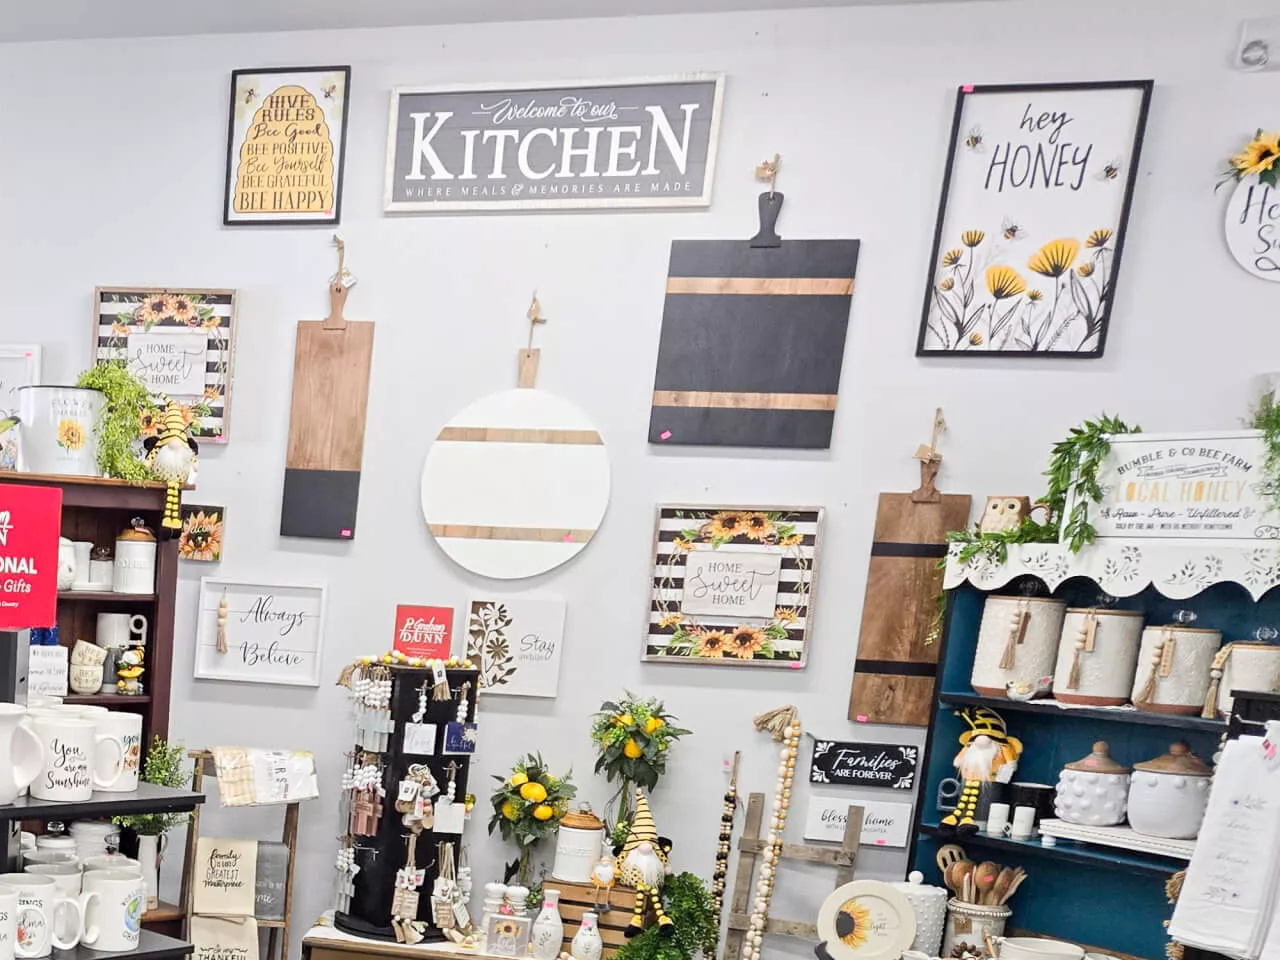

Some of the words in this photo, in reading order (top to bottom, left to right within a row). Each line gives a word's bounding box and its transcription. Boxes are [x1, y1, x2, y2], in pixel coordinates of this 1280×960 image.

[270, 95, 310, 108] HIVE
[481, 97, 565, 124] Welcome
[562, 97, 588, 121] to
[589, 102, 619, 122] our
[262, 108, 315, 122] RULES
[1020, 103, 1074, 144] hey
[253, 122, 279, 140] Bee
[284, 122, 322, 142] Good
[405, 103, 700, 181] KITCHEN
[247, 143, 269, 155] BEE
[272, 142, 327, 154] POSITIVE
[246, 157, 268, 174] Bee
[274, 153, 327, 174] Yourself
[984, 142, 1093, 192] HONEY
[242, 175, 265, 189] BEE
[267, 174, 327, 188] GRATEFUL
[405, 187, 451, 198] WHERE
[462, 185, 506, 196] MEALS
[529, 183, 605, 195] MEMORIES
[613, 183, 641, 193] ARE
[651, 182, 692, 193] MADE
[240, 191, 268, 210] BEE
[272, 190, 328, 210] HAPPY
[146, 344, 176, 353] HOME
[151, 375, 181, 385] HOME
[1117, 450, 1163, 475] BUMBLE
[1199, 448, 1220, 460] BEE
[1222, 453, 1253, 473] FARM
[1113, 481, 1170, 502] LOCAL
[1181, 480, 1247, 502] HONEY
[1186, 508, 1241, 520] Unfiltered
[708, 562, 744, 573] HOME
[3, 578, 32, 593] Gifts
[712, 595, 746, 605] HOME
[240, 594, 305, 636] Always
[402, 632, 445, 644] DUNN
[520, 634, 555, 654] Stay
[240, 641, 304, 665] Believe
[50, 738, 83, 767] You
[832, 748, 902, 771] Families
[46, 770, 90, 790] Sunshine
[864, 812, 895, 826] home
[207, 868, 239, 880] GREATEST
